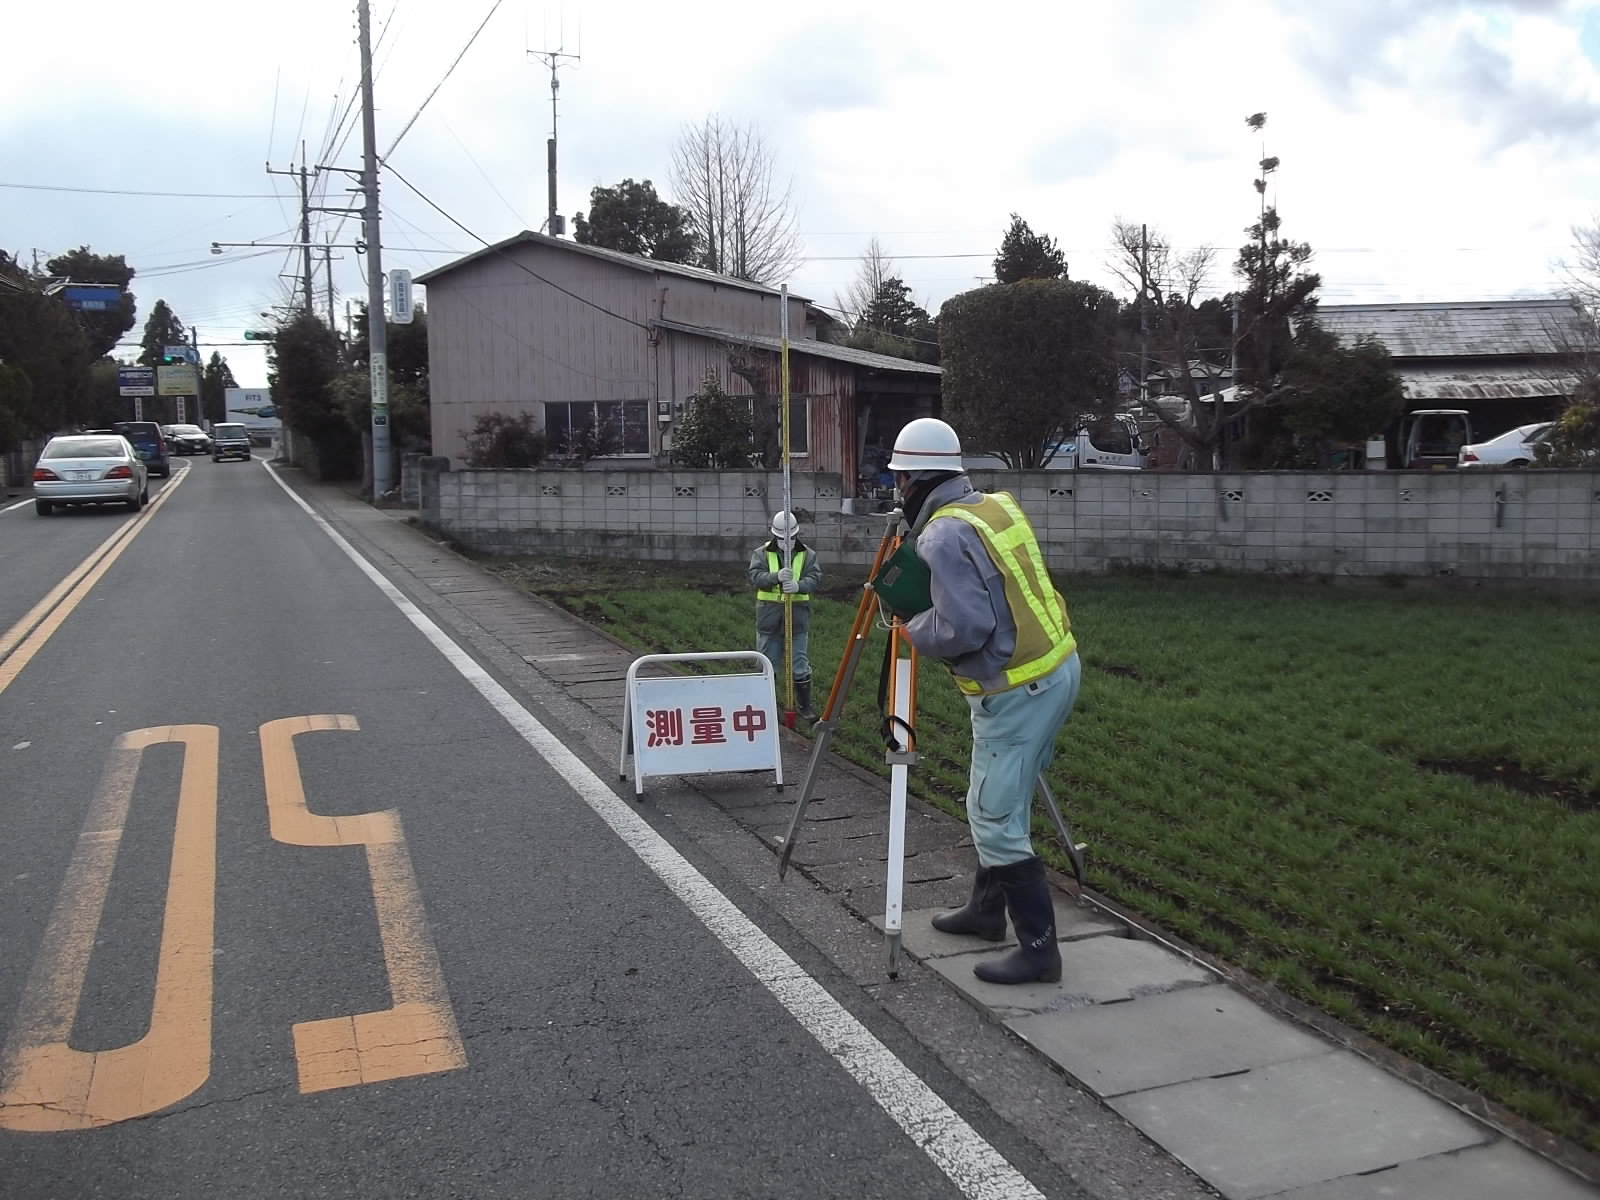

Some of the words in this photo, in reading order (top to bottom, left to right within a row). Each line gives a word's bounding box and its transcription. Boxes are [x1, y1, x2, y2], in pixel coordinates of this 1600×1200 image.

[646, 704, 767, 747] 測量中
[0, 713, 468, 1132] 50
